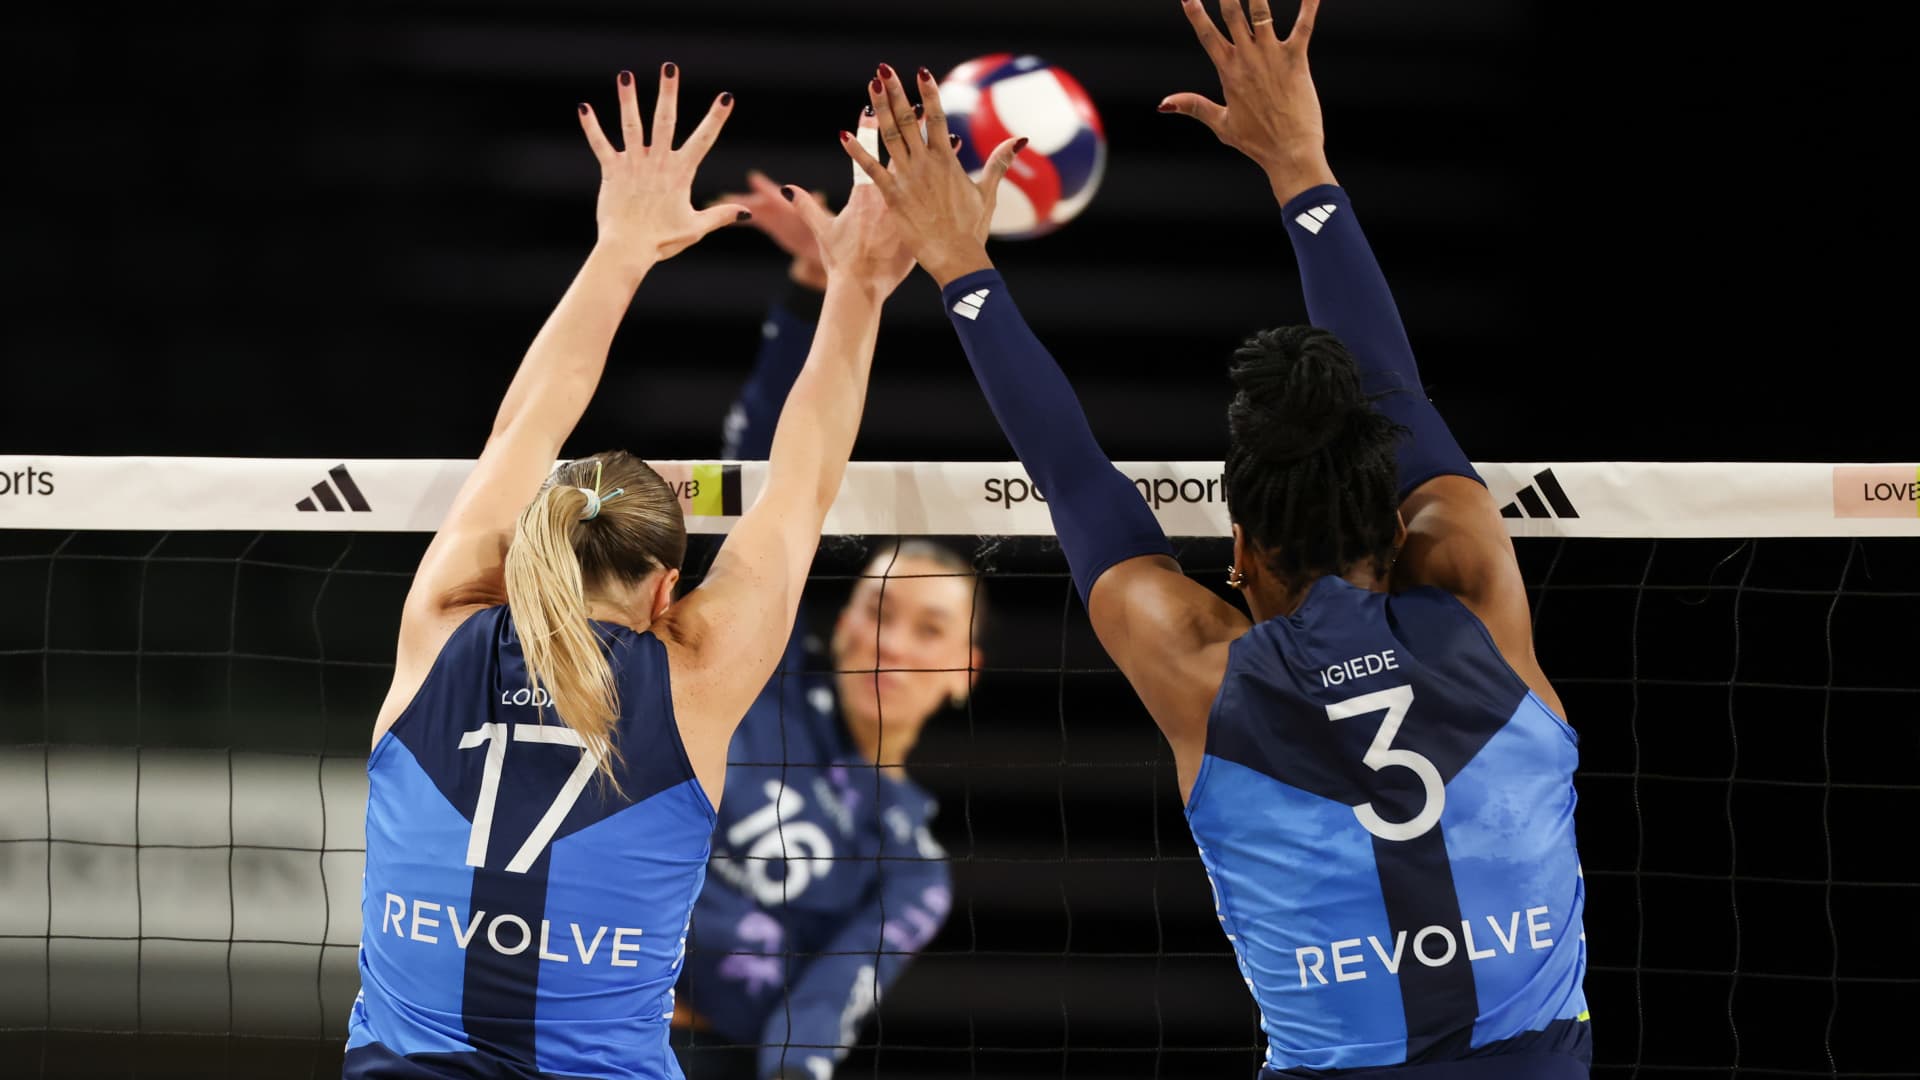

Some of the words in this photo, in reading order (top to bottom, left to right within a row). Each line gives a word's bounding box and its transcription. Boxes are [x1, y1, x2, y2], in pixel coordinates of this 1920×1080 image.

[501, 687, 556, 708] LOD
[1320, 649, 1400, 688] IGIEDE
[457, 722, 608, 874] 17
[1325, 684, 1446, 841] 3
[726, 778, 833, 906] 16
[382, 892, 643, 968] REVOLVE
[1295, 905, 1554, 988] REVOLVE
